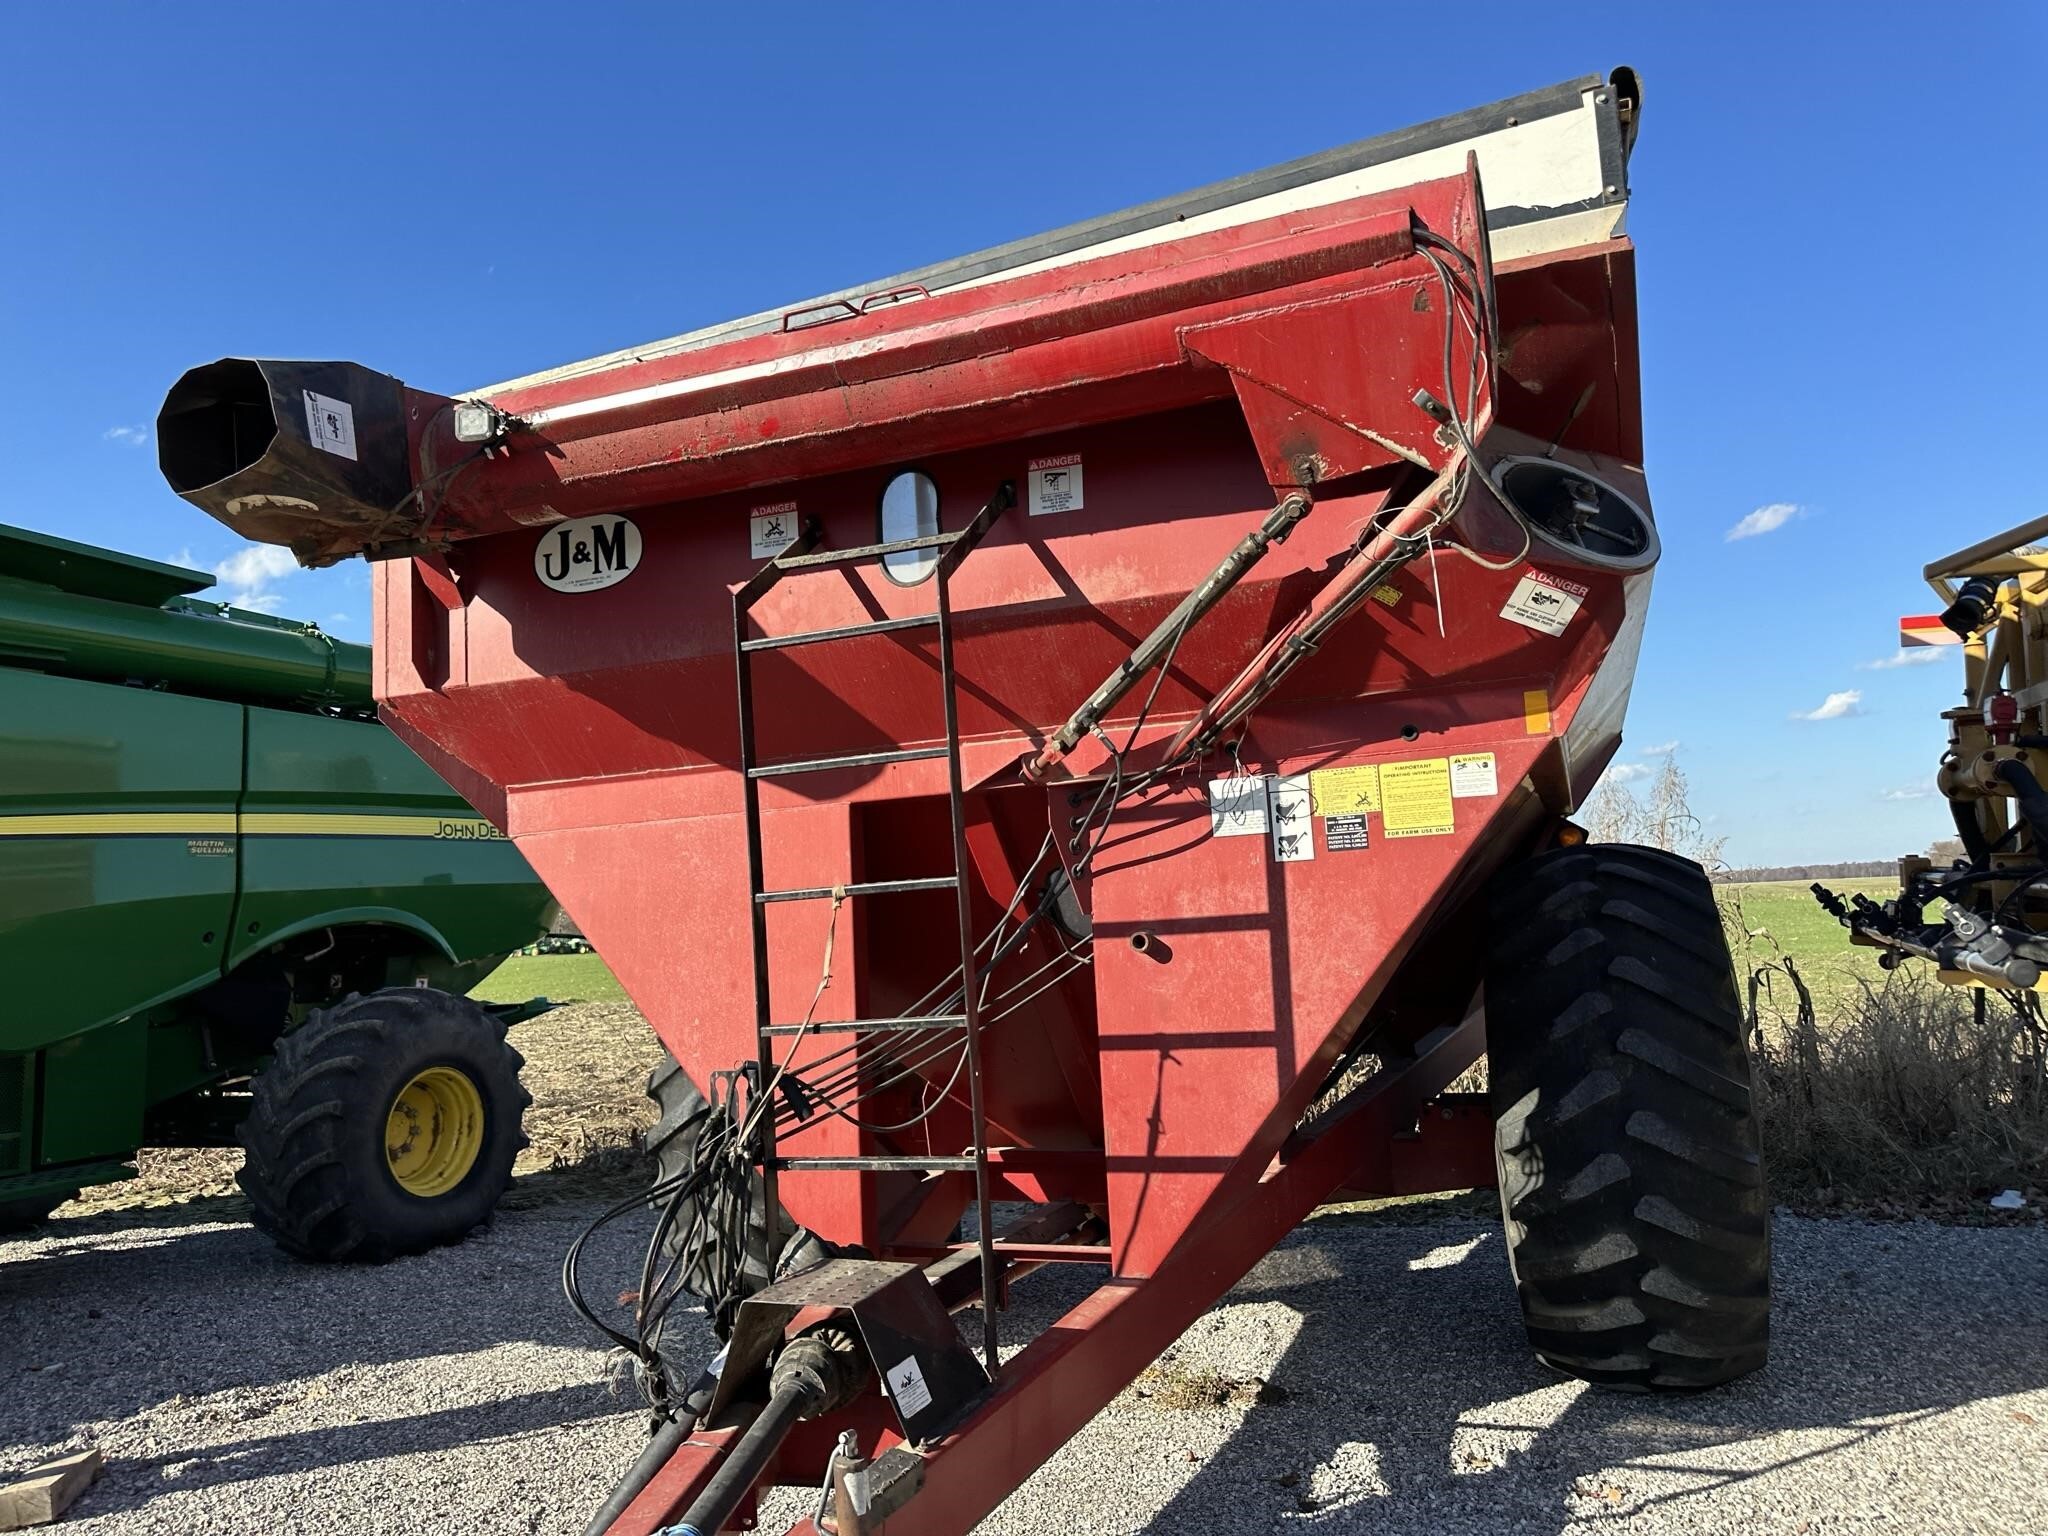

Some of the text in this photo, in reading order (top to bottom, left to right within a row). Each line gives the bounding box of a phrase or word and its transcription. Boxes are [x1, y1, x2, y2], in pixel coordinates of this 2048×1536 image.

[1039, 454, 1081, 469] DANGER
[759, 502, 797, 515] DANGER
[543, 521, 629, 581] J&M
[1537, 572, 1589, 596] DANGER
[434, 821, 475, 837] JOHN
